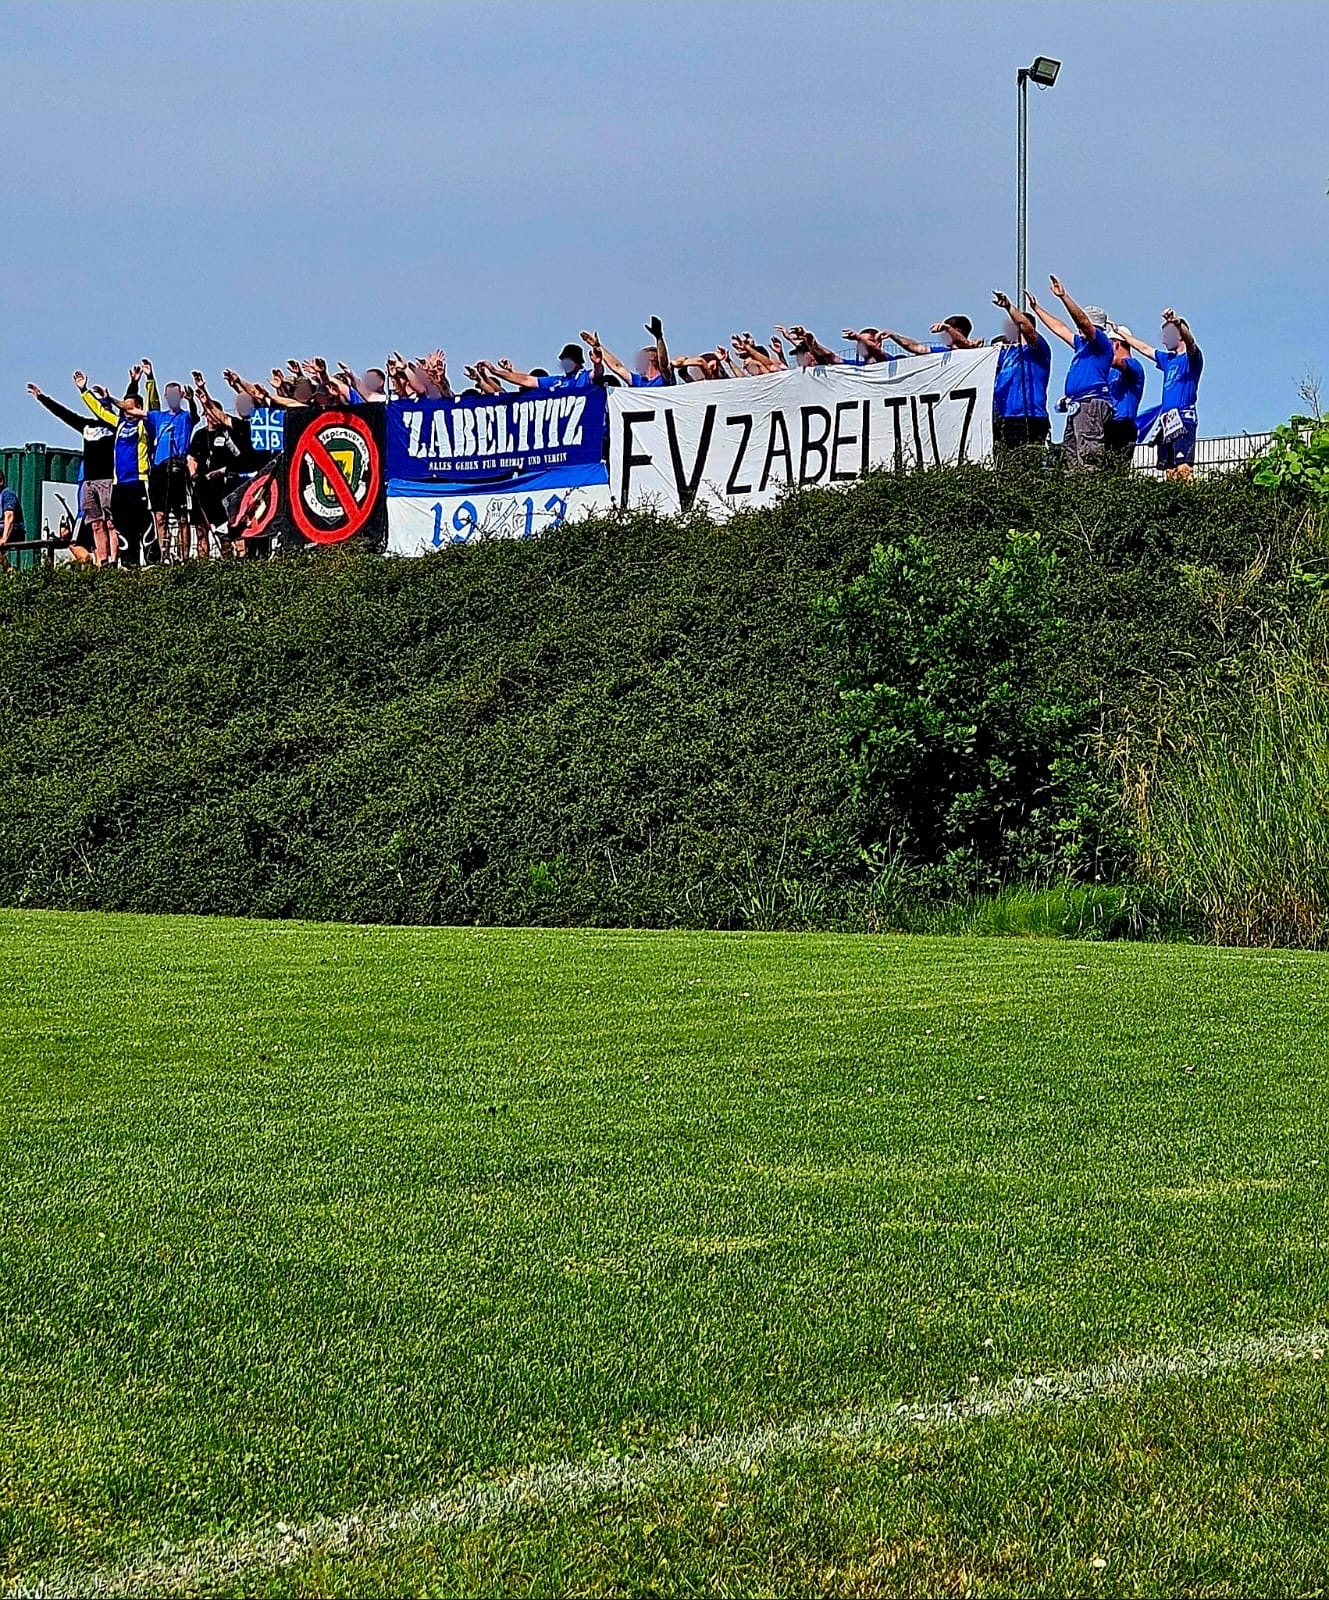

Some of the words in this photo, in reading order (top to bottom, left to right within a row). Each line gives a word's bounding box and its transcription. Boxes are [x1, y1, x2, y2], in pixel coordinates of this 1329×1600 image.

[402, 396, 586, 458] ZABELTITZ
[621, 404, 717, 512] FV
[726, 387, 977, 495] ZABELTITZ
[428, 461, 452, 471] ALLES
[455, 460, 478, 471] GEBEN
[500, 457, 524, 469] HEIMAT
[528, 455, 541, 465] UND
[544, 452, 567, 463] VEREIN
[430, 500, 478, 547] 19
[491, 501, 503, 512] SV
